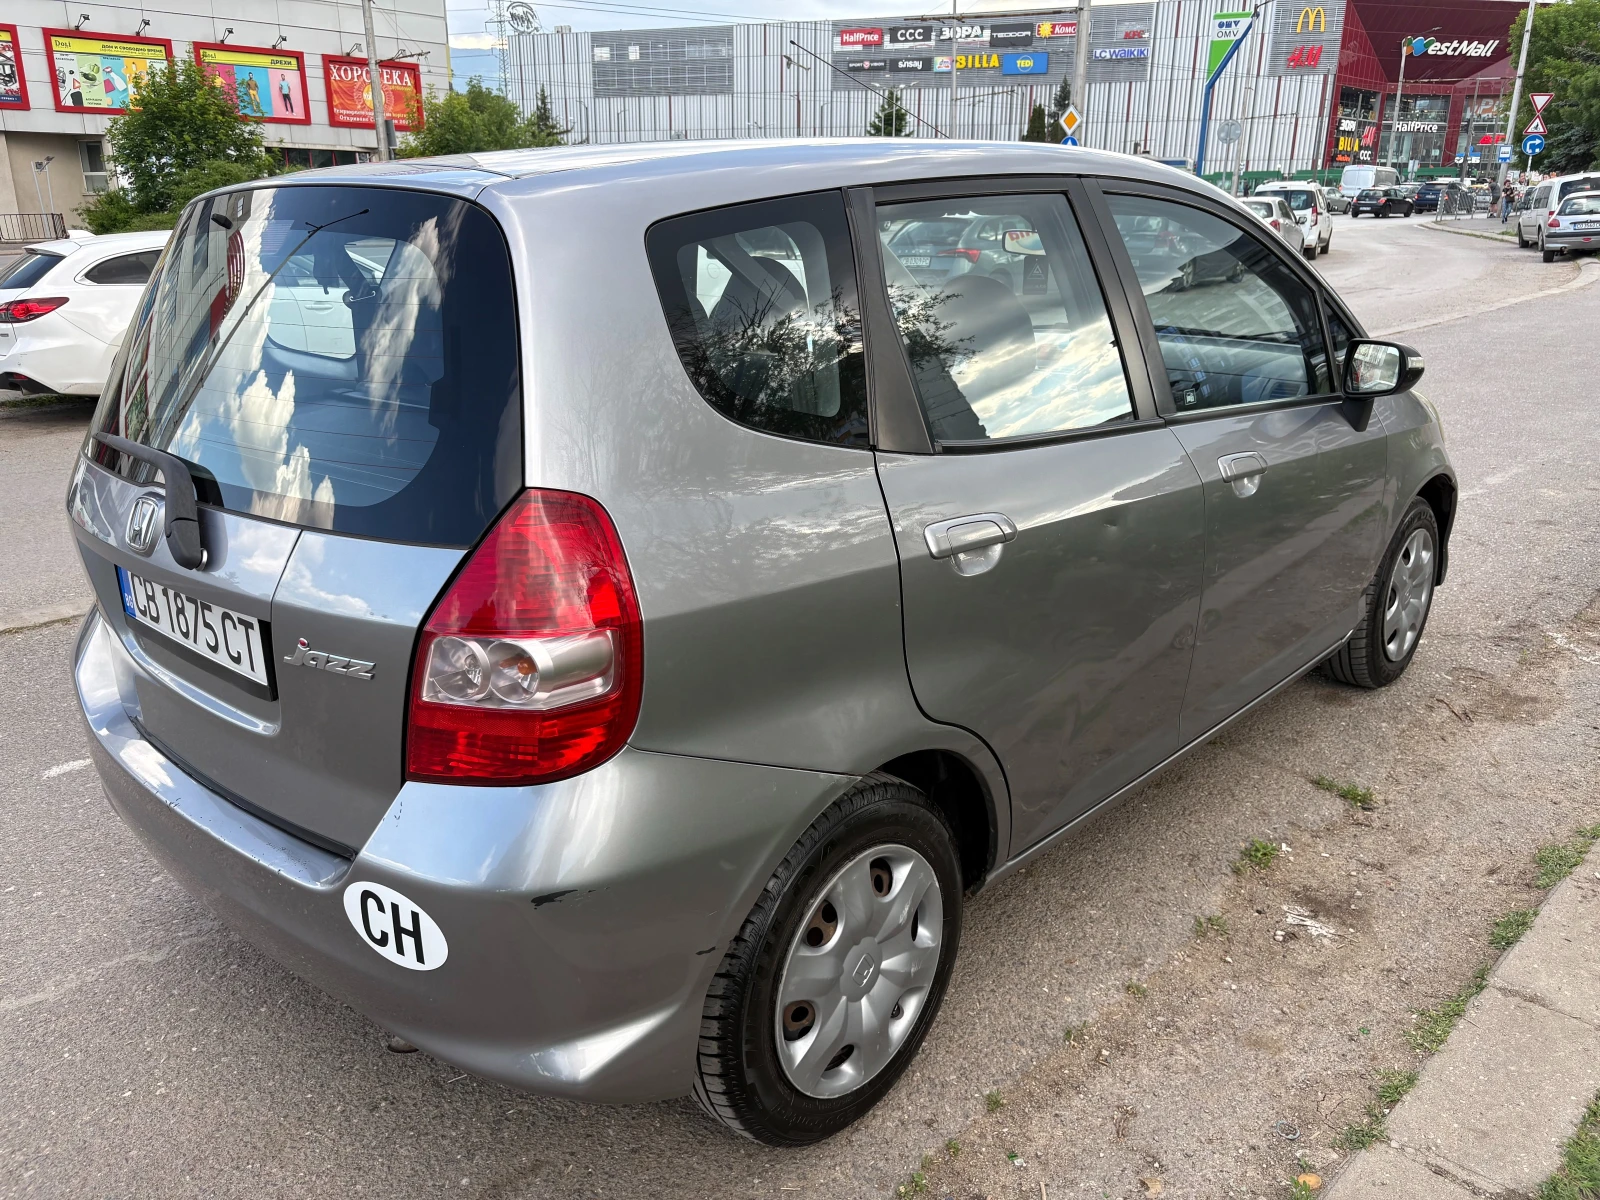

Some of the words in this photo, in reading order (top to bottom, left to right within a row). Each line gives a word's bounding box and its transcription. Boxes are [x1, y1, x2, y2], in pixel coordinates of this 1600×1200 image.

[897, 28, 924, 41] CCC
[1054, 24, 1077, 35] Комс
[1216, 30, 1239, 39] OMV
[843, 32, 879, 43] HalfPrice
[1093, 49, 1108, 60] LC
[897, 59, 923, 70] sinsay
[956, 54, 1000, 69] BILLA
[329, 64, 412, 86] ХОРОЕКА
[1395, 120, 1438, 133] HalfPrice
[1360, 149, 1371, 161] CCC
[130, 573, 161, 625] CB
[161, 586, 220, 655] 1875
[220, 610, 257, 674] CT
[360, 889, 425, 966] CH
